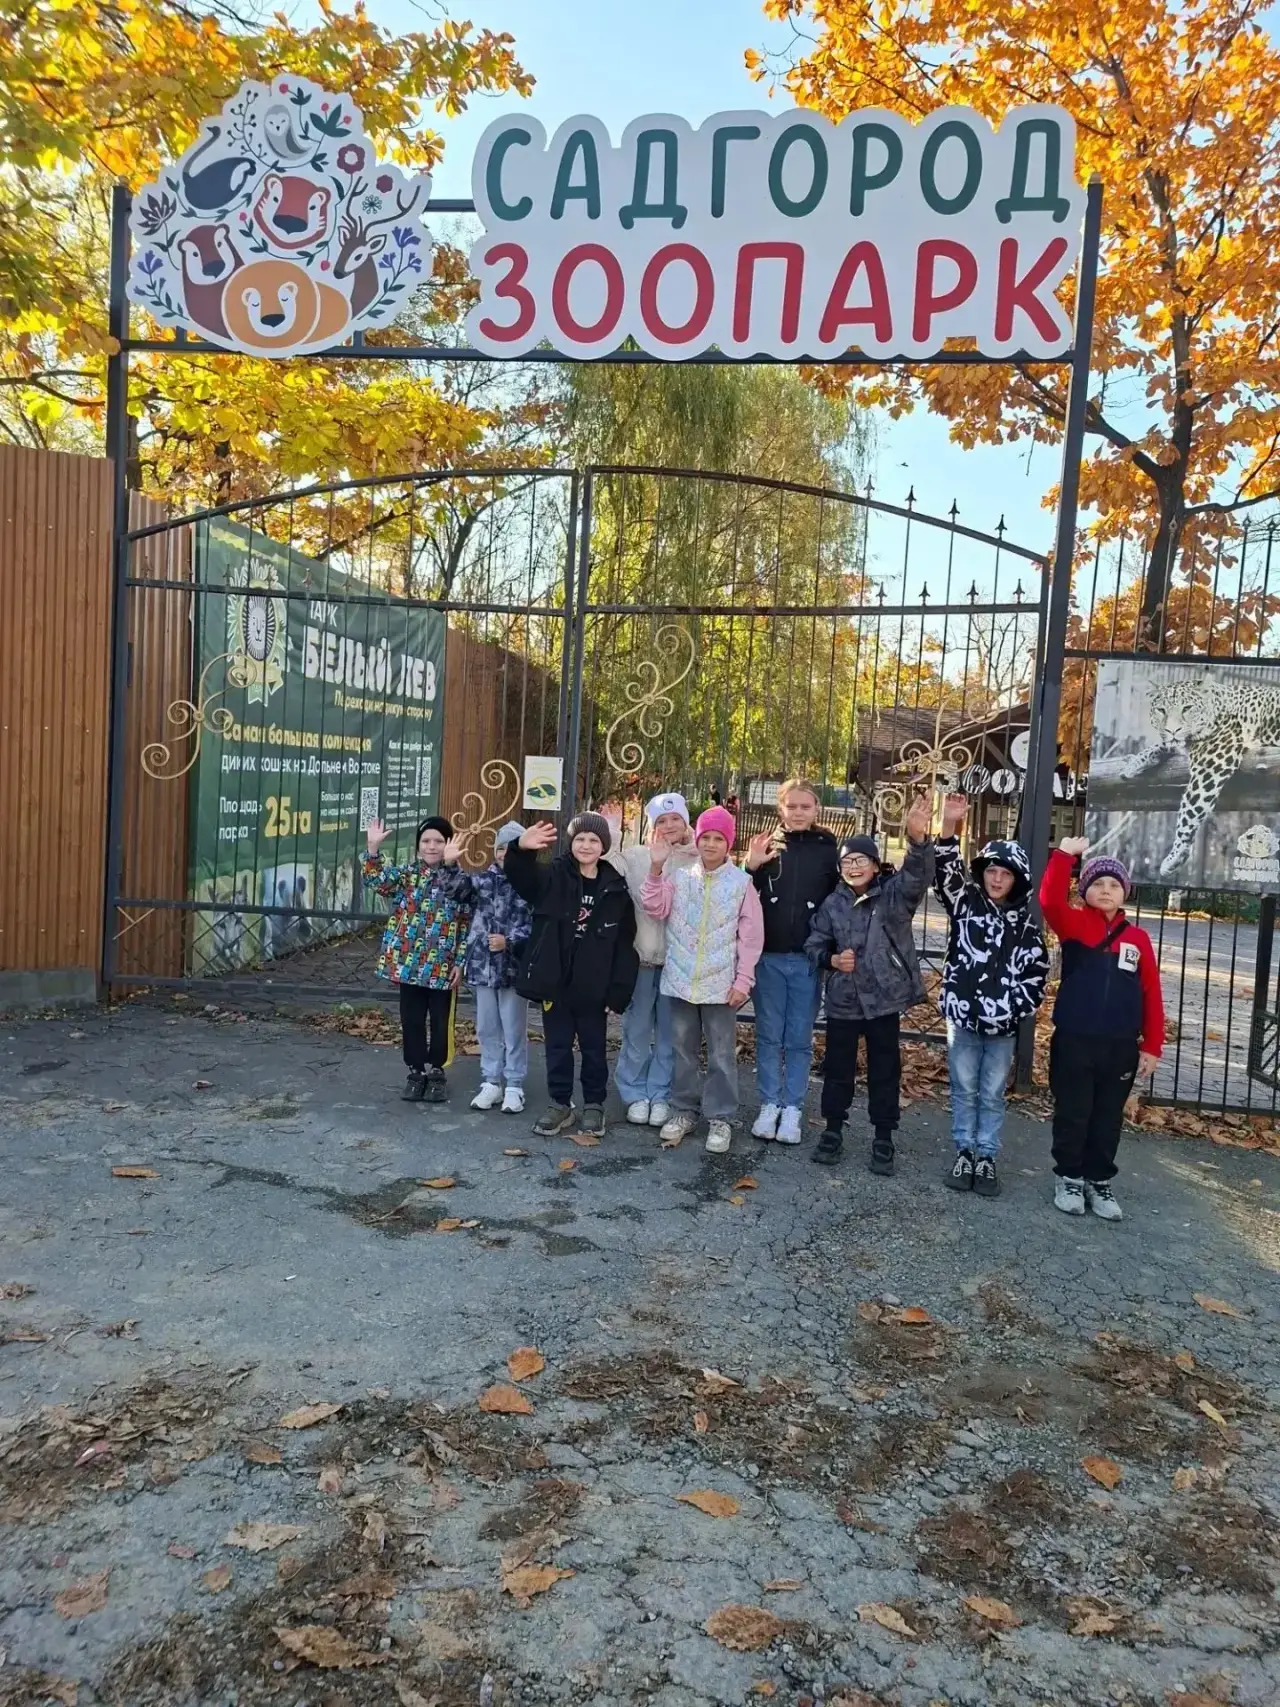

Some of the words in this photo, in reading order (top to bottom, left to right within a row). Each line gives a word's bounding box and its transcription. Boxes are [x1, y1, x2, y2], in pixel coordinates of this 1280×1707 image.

[486, 119, 1070, 229] САДГОРОД
[480, 237, 1067, 345] ЗООПАРК
[301, 625, 392, 695] БЕЛЫЙ
[396, 654, 436, 701] ЛЕВ
[384, 702, 404, 718] дику
[268, 722, 320, 748] большая
[218, 825, 249, 843] парка
[264, 796, 291, 838] 25
